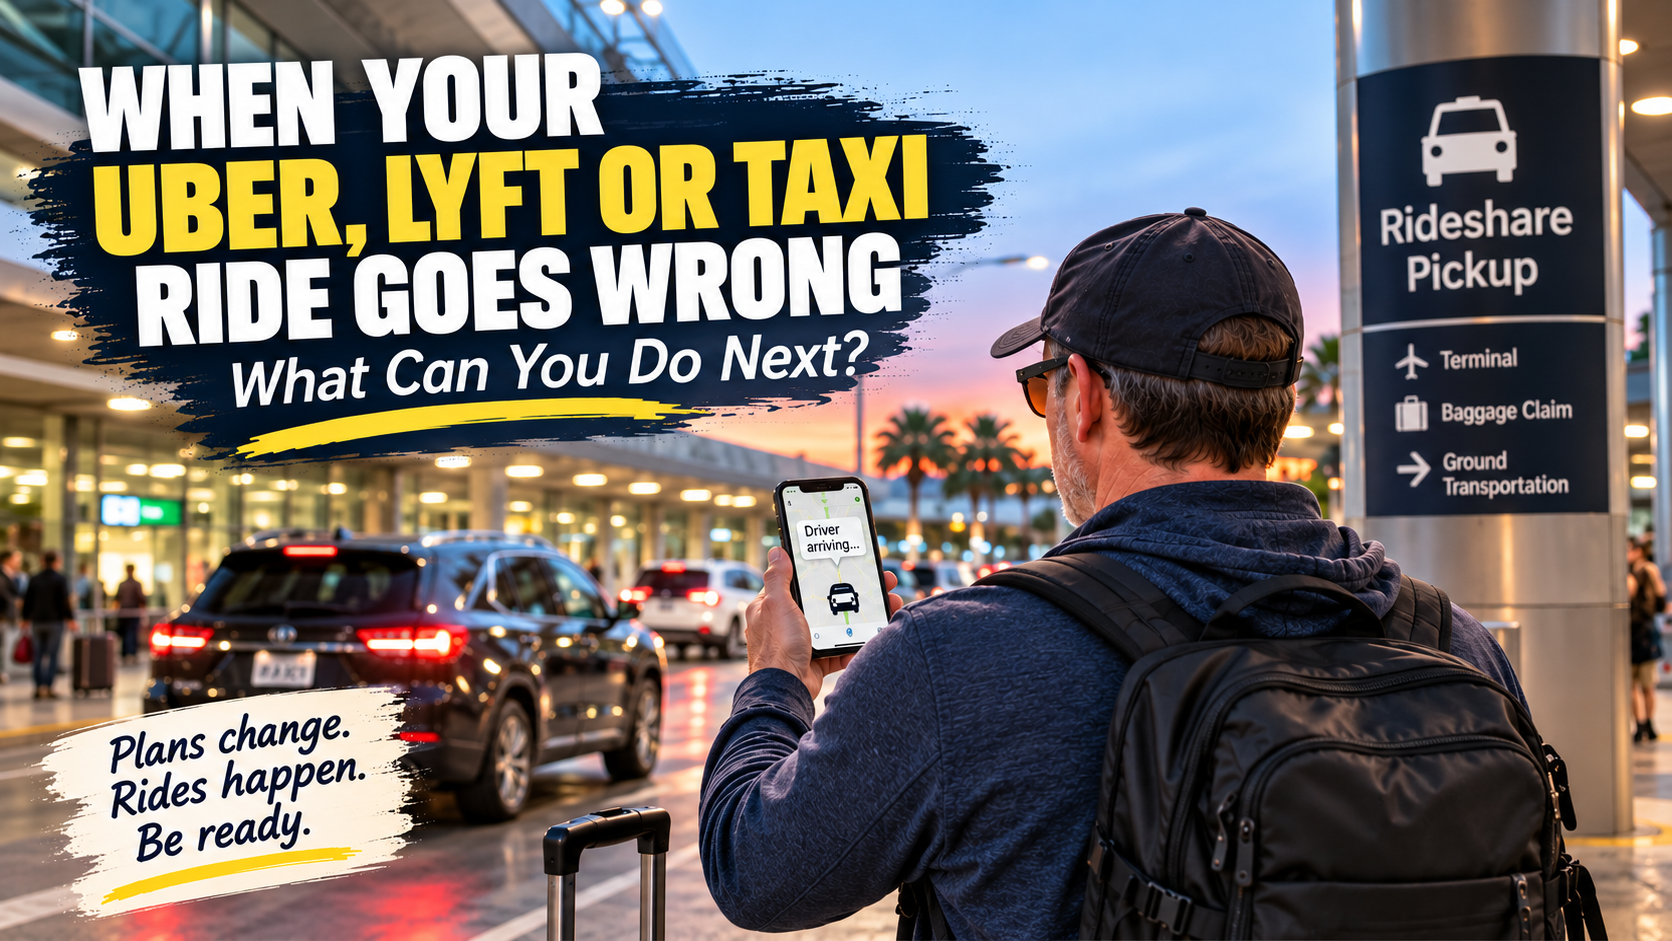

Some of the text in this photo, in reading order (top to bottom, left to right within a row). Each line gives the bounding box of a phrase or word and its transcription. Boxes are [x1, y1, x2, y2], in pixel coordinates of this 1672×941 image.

[1380, 199, 1573, 246] Rideshare
[1407, 250, 1539, 296] Pickup
[1440, 347, 1518, 370] Terminal
[1441, 399, 1573, 426] Baggage Claim
[1442, 450, 1508, 472] Ground
[1442, 474, 1569, 499] Transportation
[804, 524, 839, 537] Driver
[807, 539, 859, 553] arriving...
